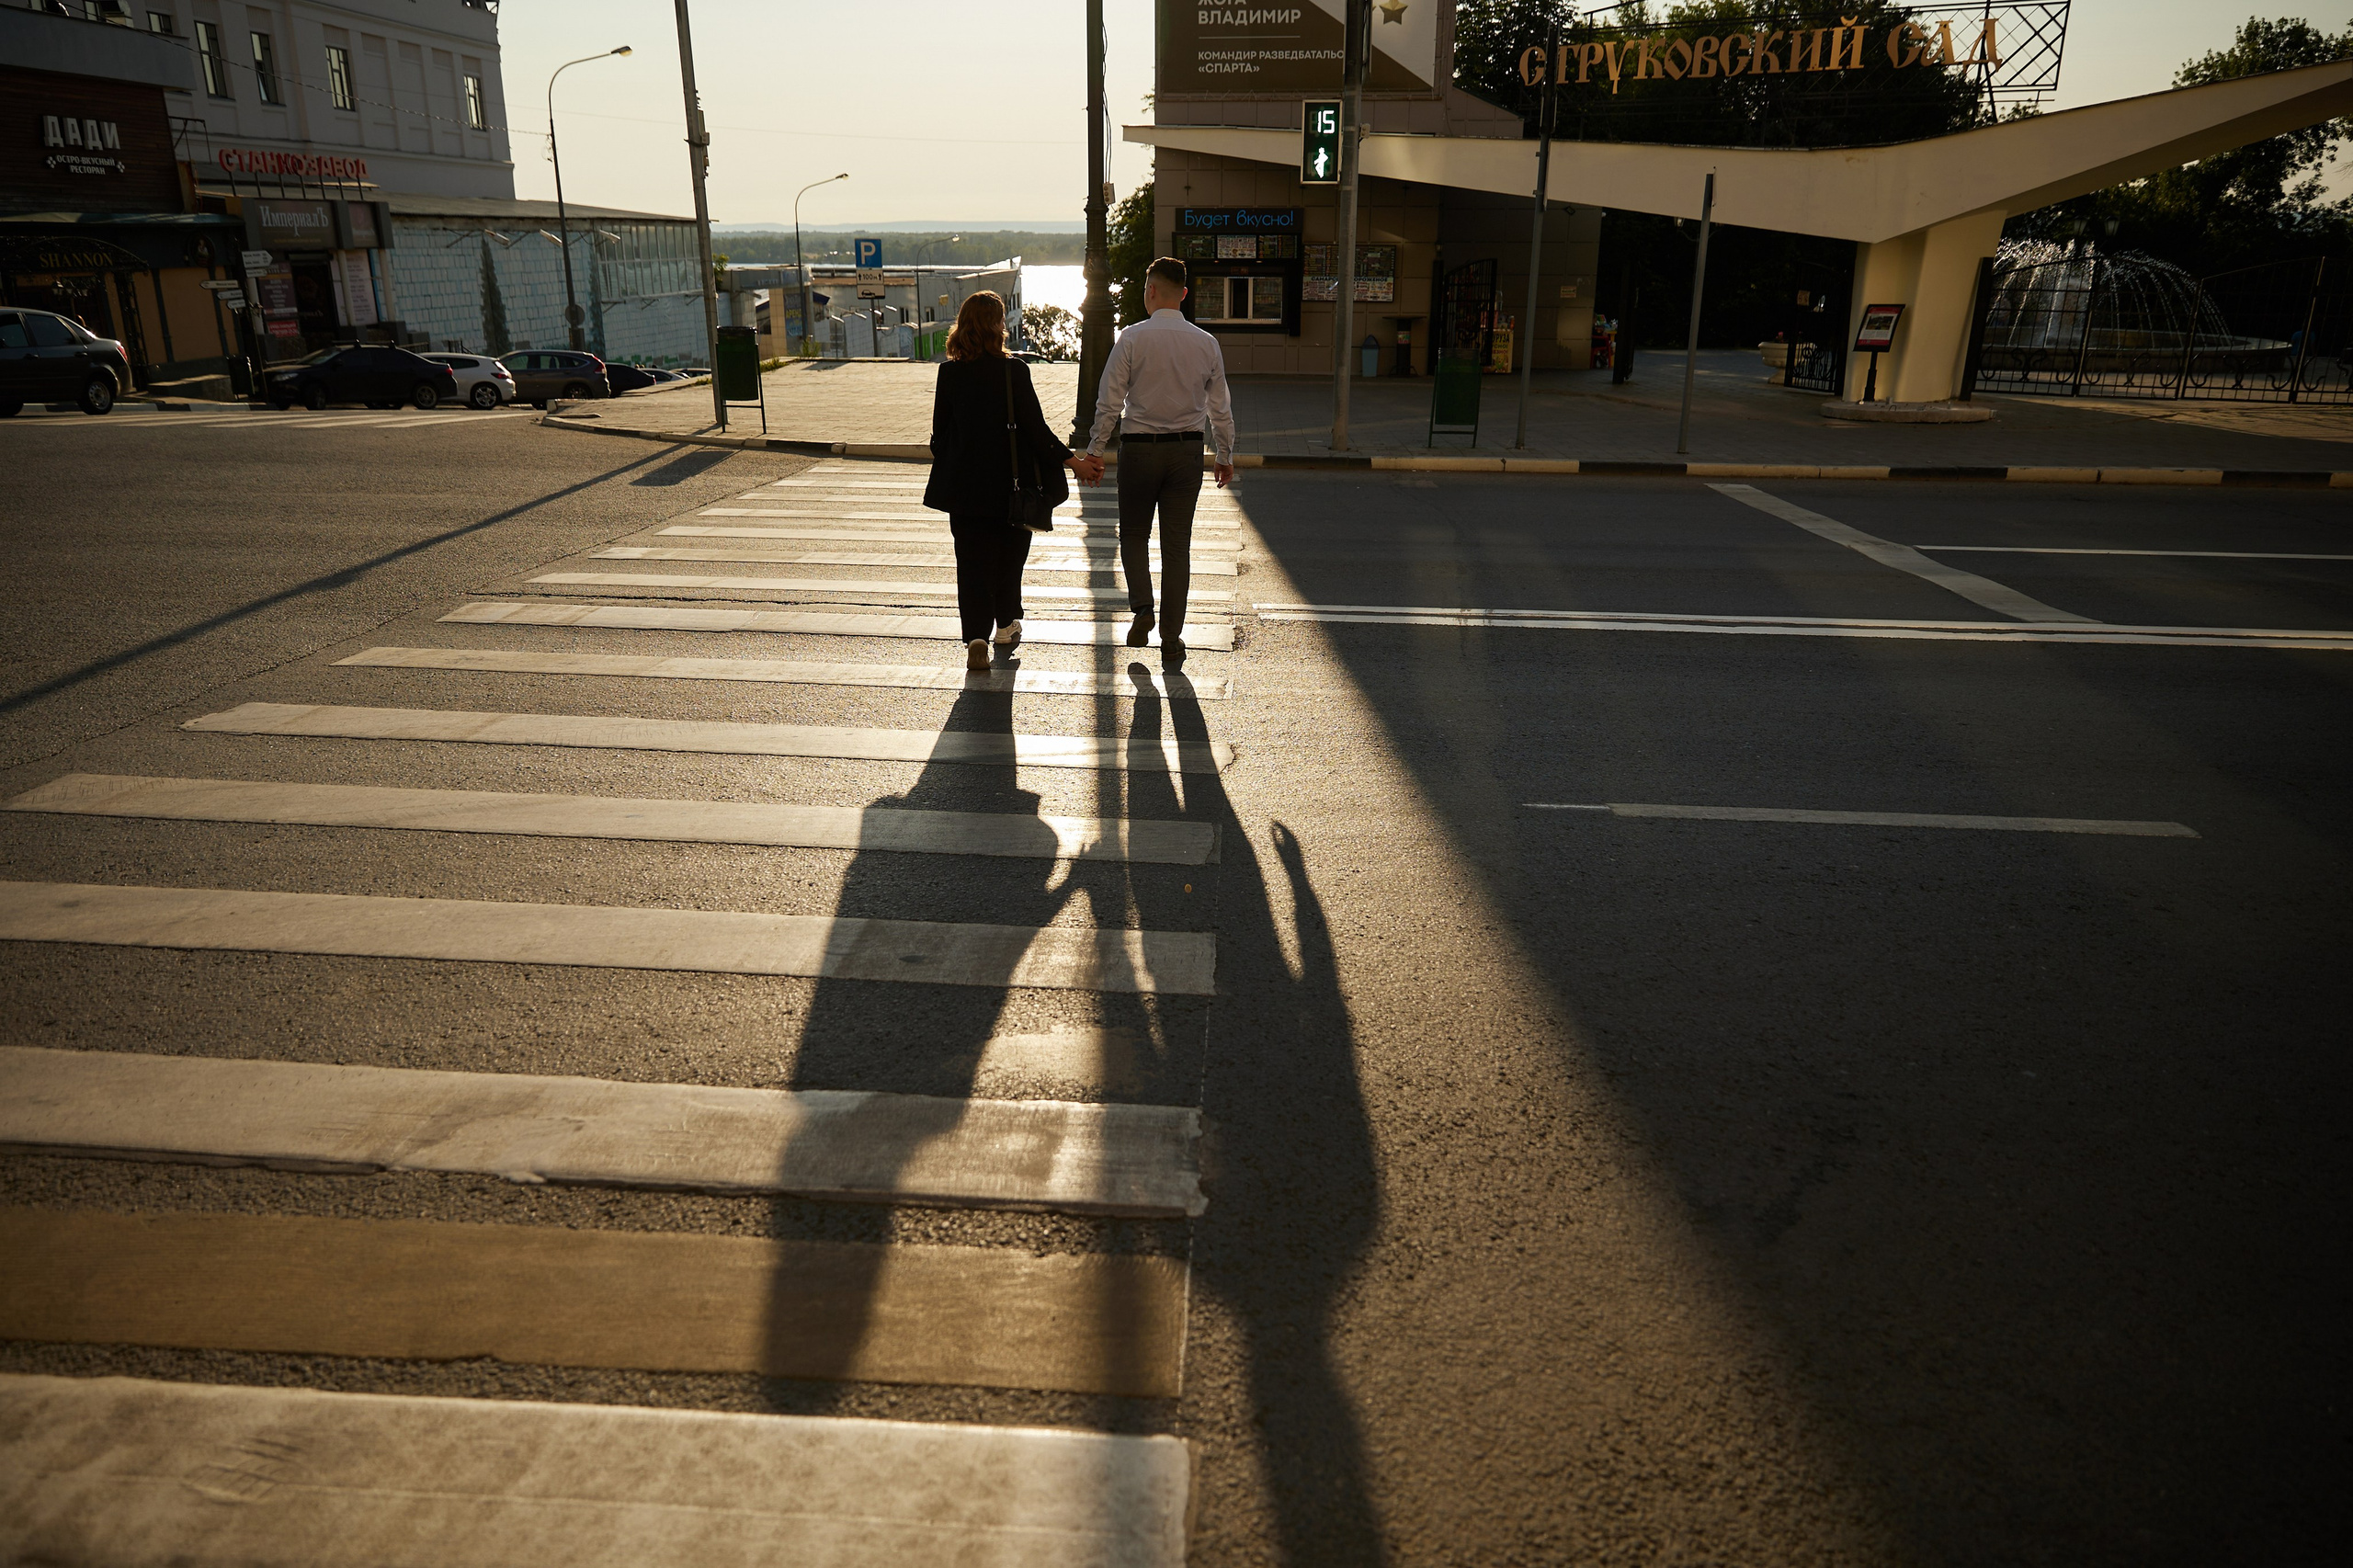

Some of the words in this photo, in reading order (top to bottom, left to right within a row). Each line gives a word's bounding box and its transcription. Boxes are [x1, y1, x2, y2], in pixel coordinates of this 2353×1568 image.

[1198, 9, 1302, 26] ВЛАДИМИР
[1198, 51, 1257, 62] КОМАНДИР
[1259, 50, 1344, 61] РАЗВЕДБАТАЛЬО
[1518, 15, 1870, 95] СТРУКОВСКИЙ
[1886, 18, 2003, 74] САД
[1198, 62, 1261, 74] «СПАРТА»
[1317, 109, 1336, 134] 15
[42, 115, 121, 151] ДАДИ
[56, 154, 116, 167] ОСТРО-ВКУСНЫЙ
[70, 165, 107, 176] РЕСТОРАН
[219, 149, 370, 180] СТАНКОЗАВОД
[259, 205, 330, 237] ИмпериалЪ
[1185, 210, 1231, 229] Будет
[1236, 209, 1294, 228] вкусно!
[39, 252, 115, 268] SHANNON
[860, 241, 876, 265] P
